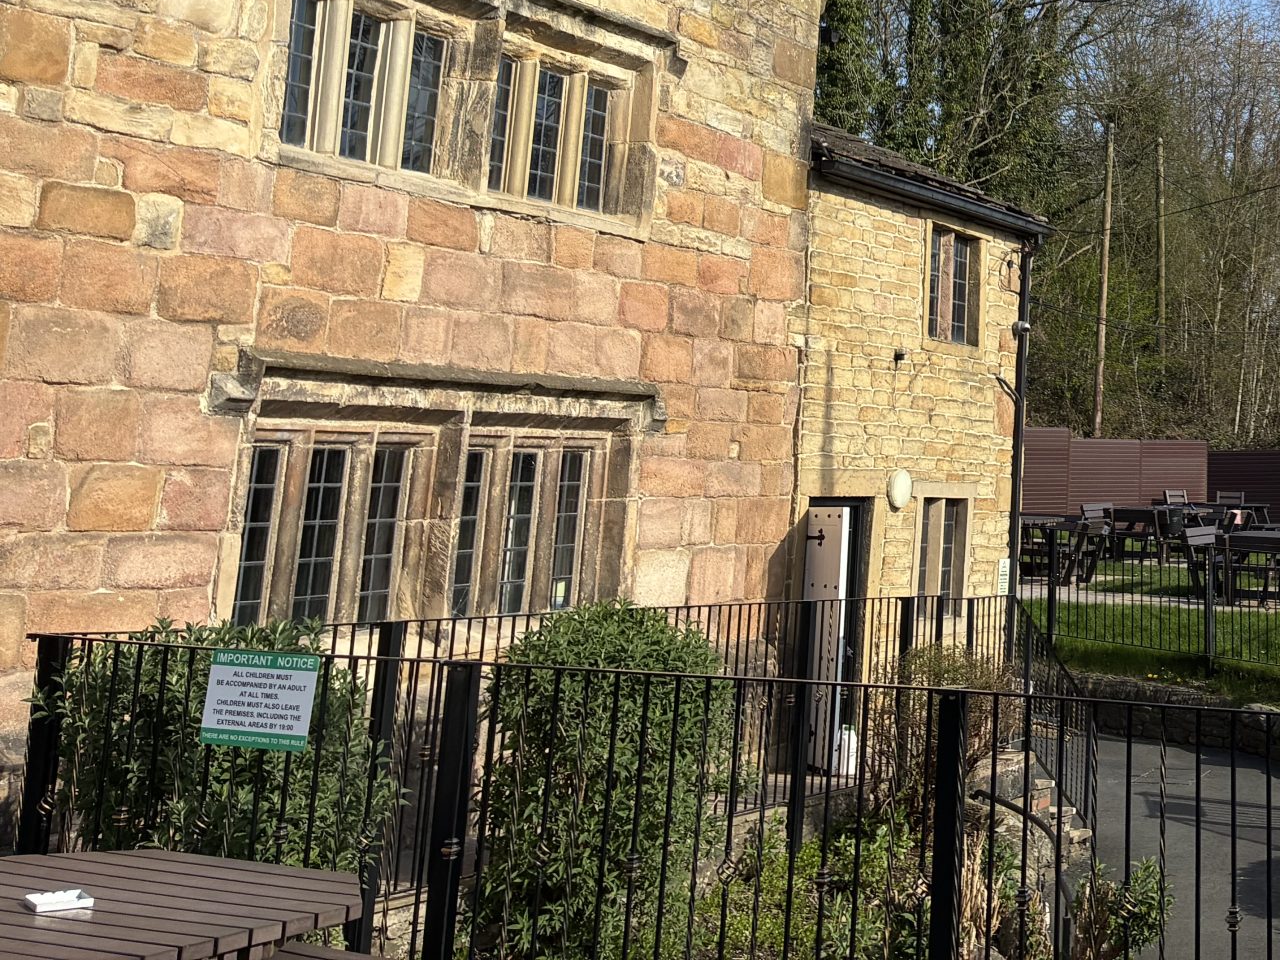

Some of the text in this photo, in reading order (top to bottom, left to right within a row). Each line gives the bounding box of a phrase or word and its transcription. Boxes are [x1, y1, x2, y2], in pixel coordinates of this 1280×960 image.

[216, 652, 315, 669] IMPORTANT NOTICE
[232, 670, 293, 681] ALL CHILDREN MUST
[225, 680, 268, 689] ACCOMPANIED
[277, 683, 287, 691] AN
[287, 684, 307, 692] ADULT
[247, 691, 259, 699] ALL
[216, 699, 301, 712] CHILDREN MUST ALSO LEAVE
[212, 708, 224, 716] THE
[256, 712, 289, 721] INCLUDING
[290, 714, 302, 722] THE
[216, 719, 247, 728] EXTERNAL
[247, 721, 268, 729] AREAS
[238, 735, 270, 744] EXCEPTIONS
[278, 738, 290, 746] THIS
